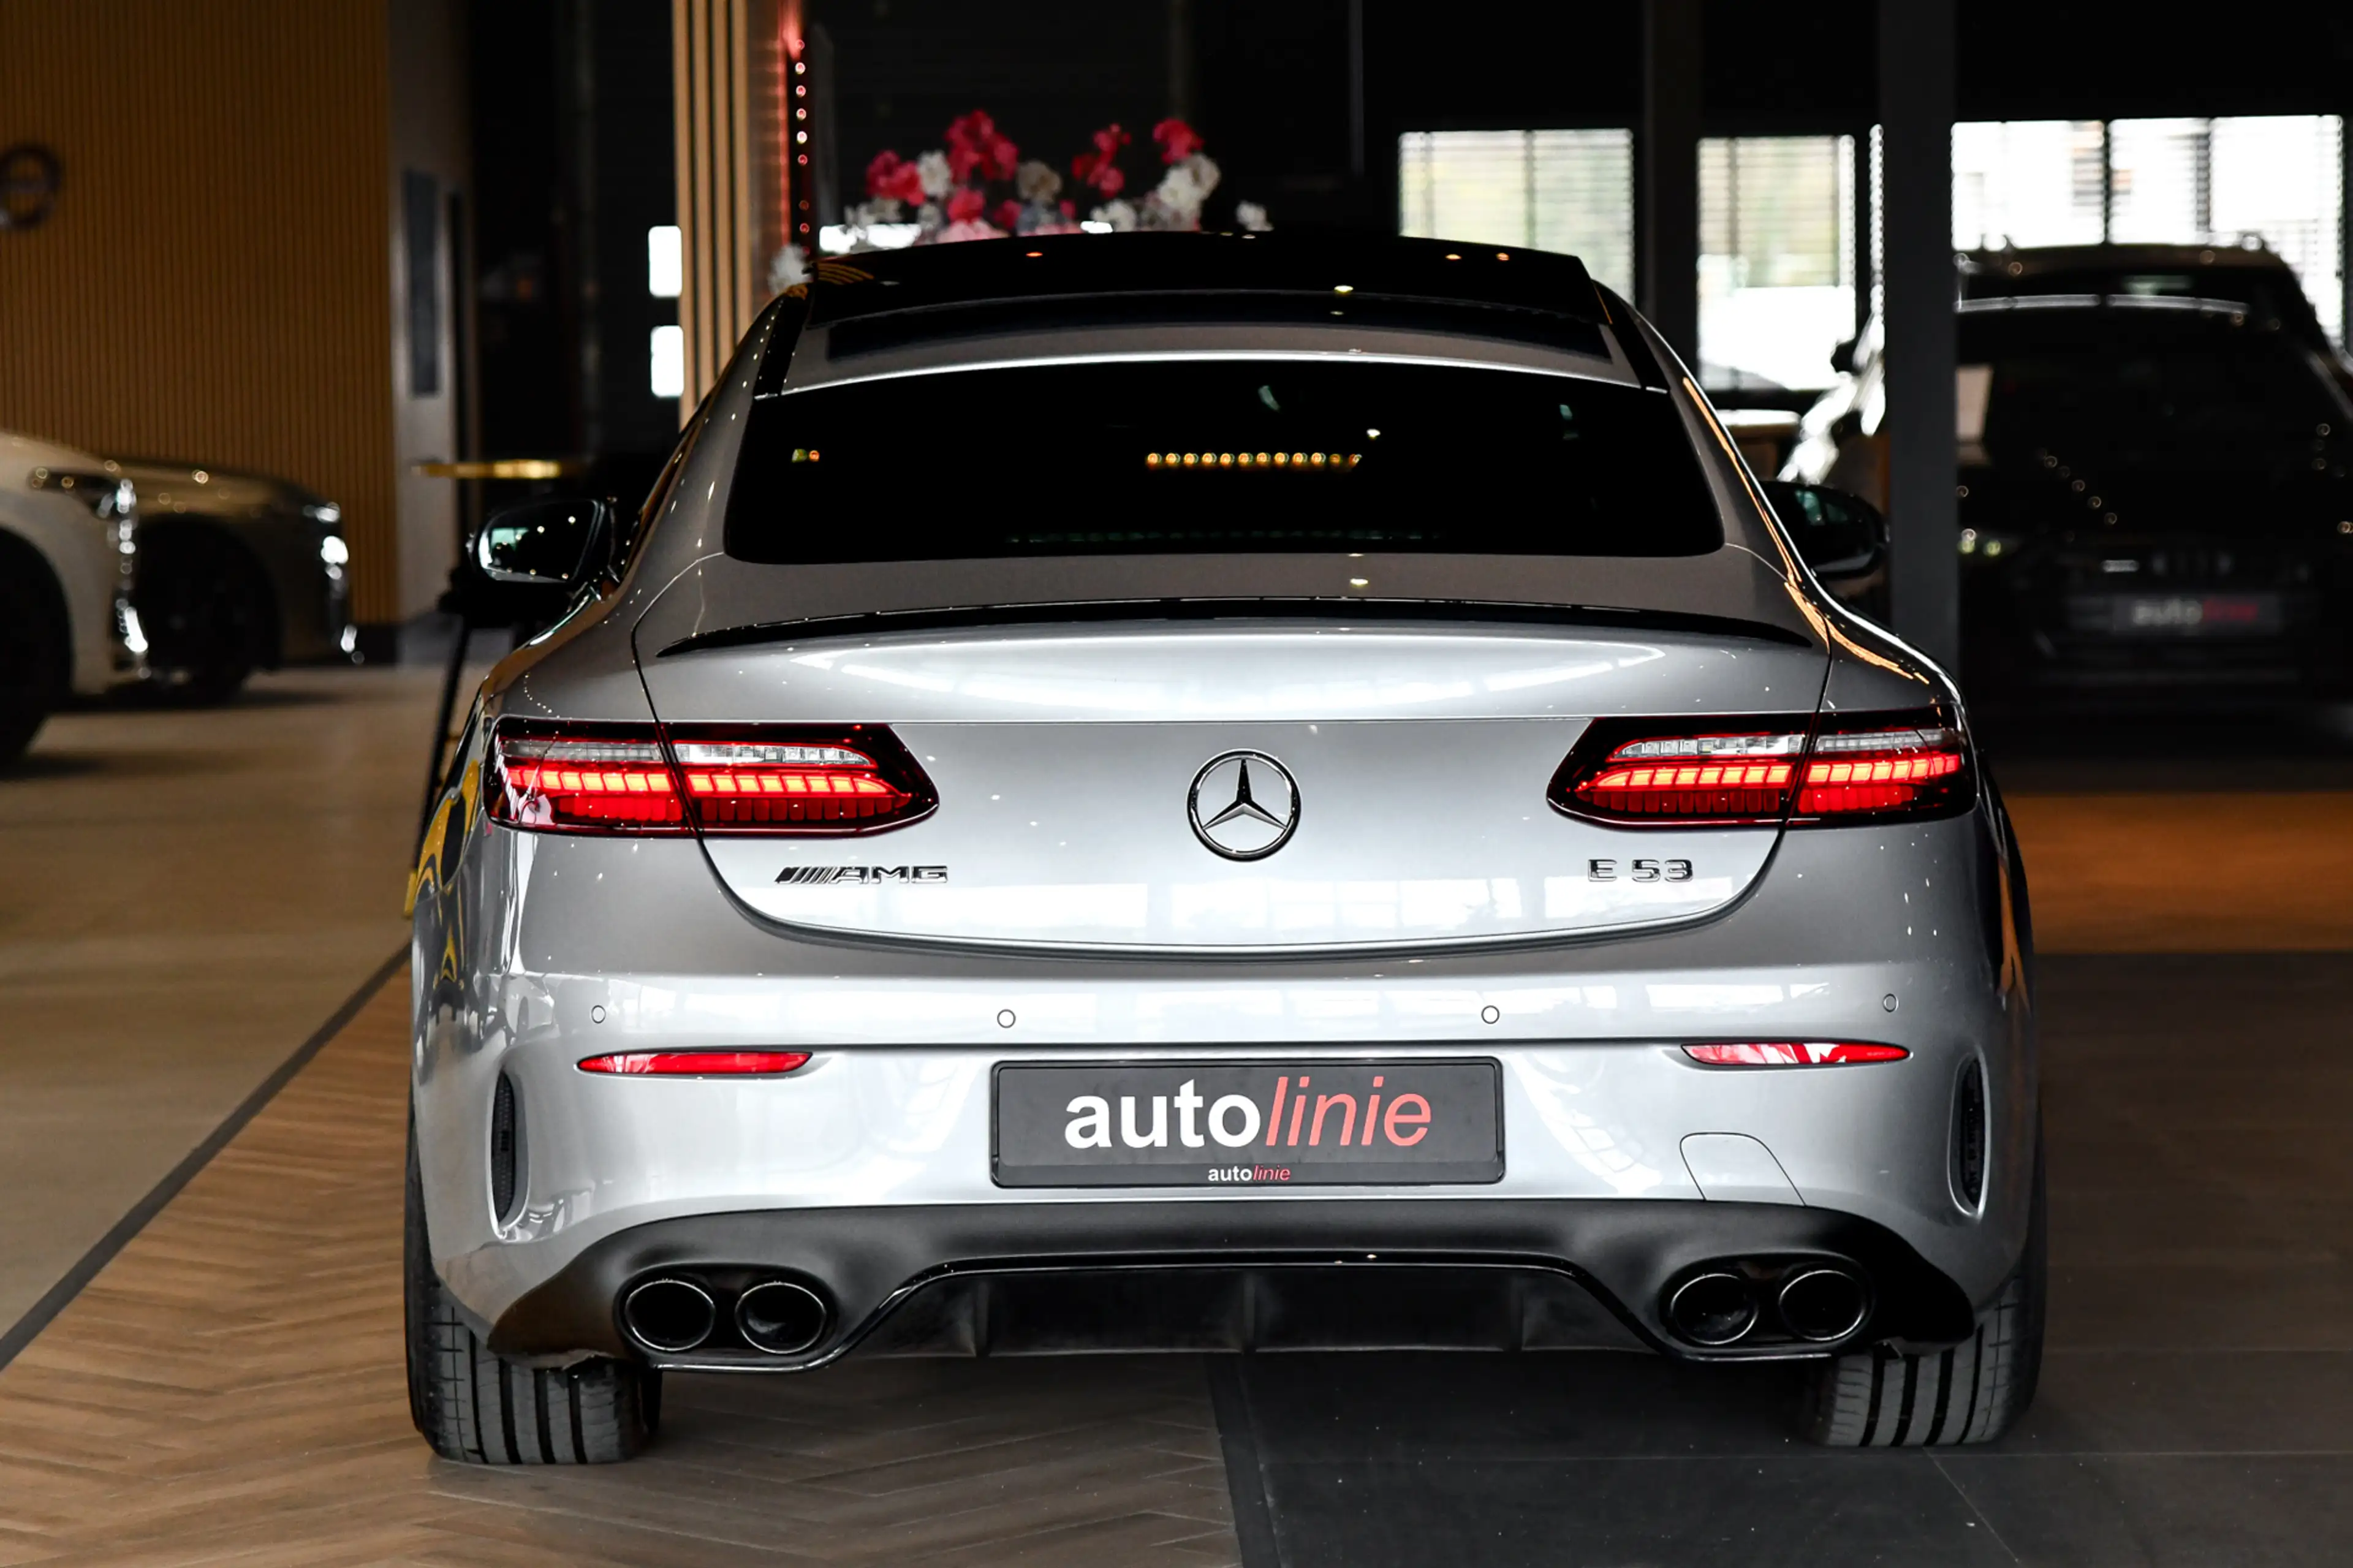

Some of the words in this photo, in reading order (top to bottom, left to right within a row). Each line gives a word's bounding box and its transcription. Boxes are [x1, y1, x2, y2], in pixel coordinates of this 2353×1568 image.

[832, 865, 948, 884] AMG
[1588, 859, 1617, 882] E
[1632, 859, 1693, 882] 53
[1064, 1076, 1431, 1148] autolinie
[1208, 1165, 1290, 1181] autolinie
